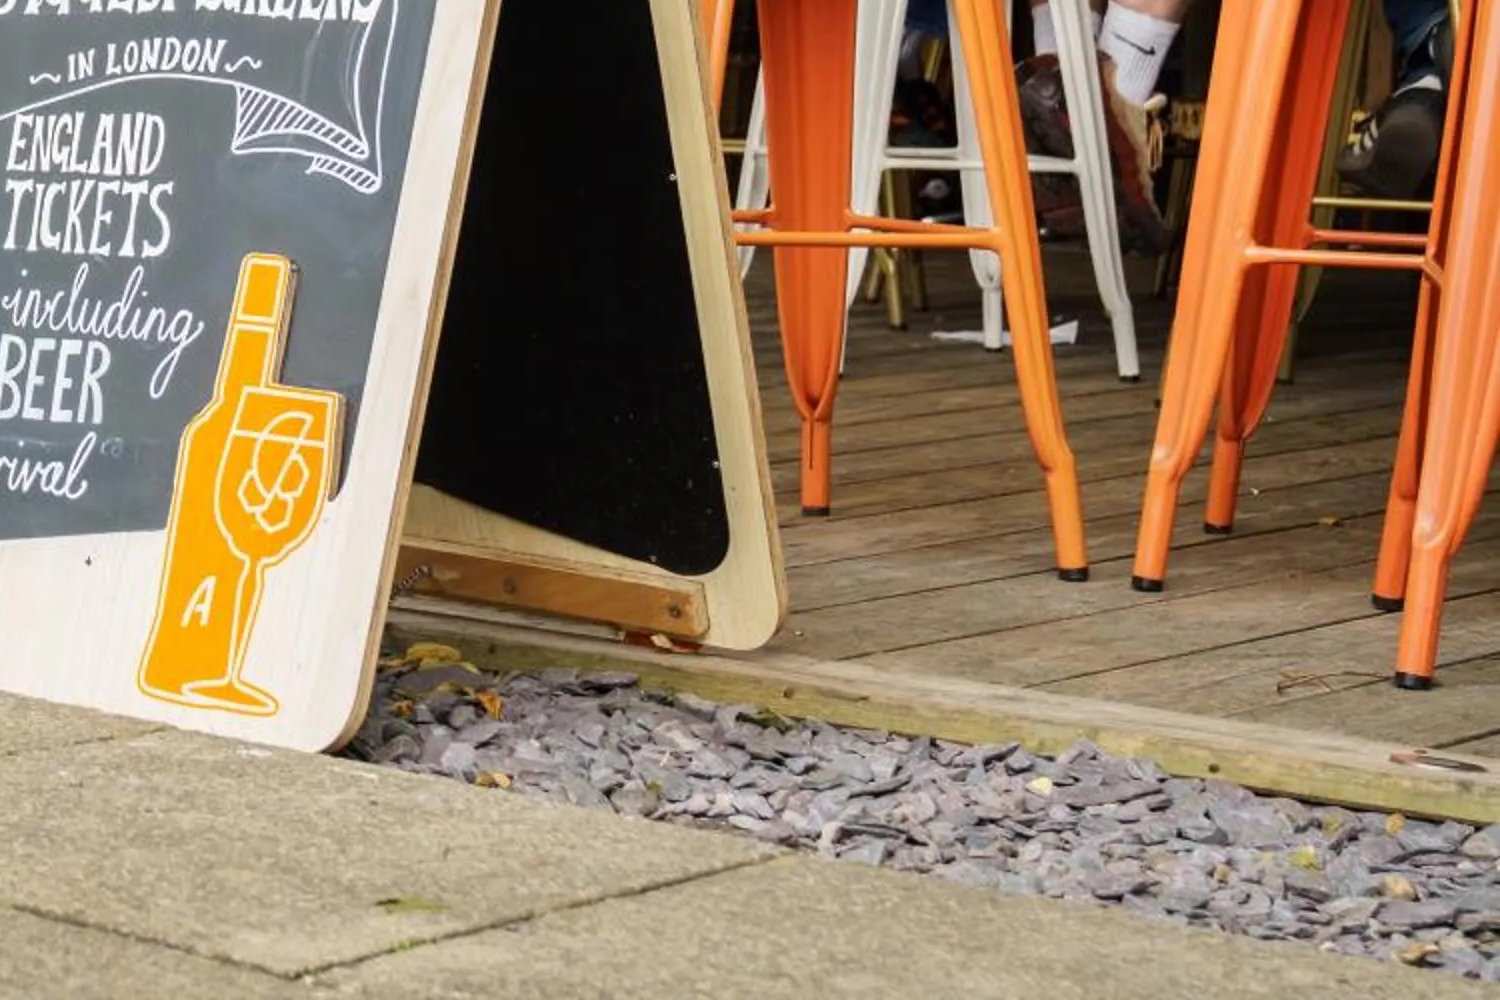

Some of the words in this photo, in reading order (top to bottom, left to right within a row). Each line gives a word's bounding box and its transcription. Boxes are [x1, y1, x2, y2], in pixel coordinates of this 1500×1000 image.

[67, 48, 95, 82] IN
[105, 37, 228, 75] LONDON
[5, 111, 166, 176] ENGLAND
[3, 178, 175, 259] TICKETS
[2, 264, 205, 399] including
[181, 575, 215, 627] A
